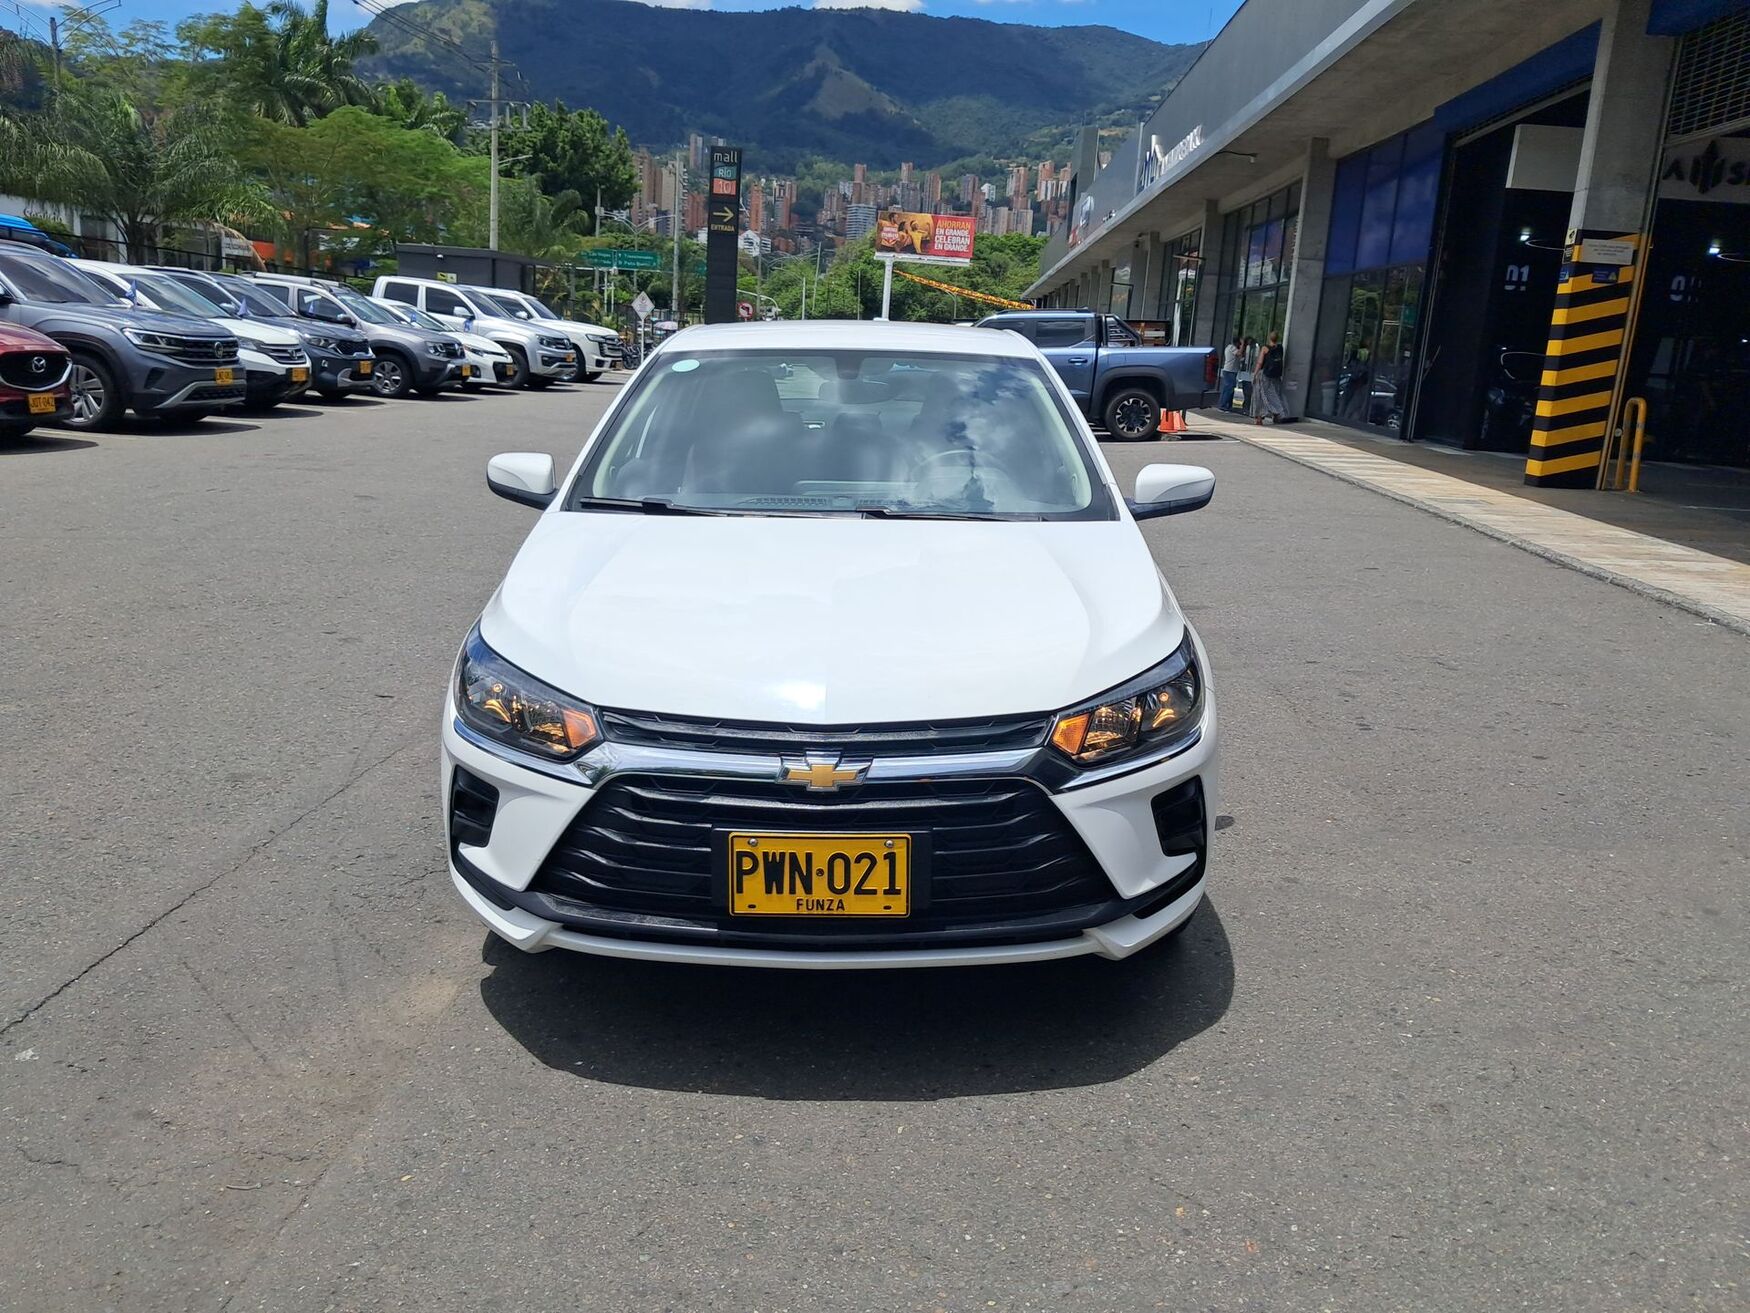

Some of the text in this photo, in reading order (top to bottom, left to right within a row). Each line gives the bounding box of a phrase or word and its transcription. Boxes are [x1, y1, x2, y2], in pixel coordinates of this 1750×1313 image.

[713, 151, 738, 163] mall
[710, 223, 735, 232] ENTRADA
[936, 220, 971, 230] AHORRAN
[935, 234, 970, 245] CELEBRAN
[796, 899, 845, 911] FUNZA
